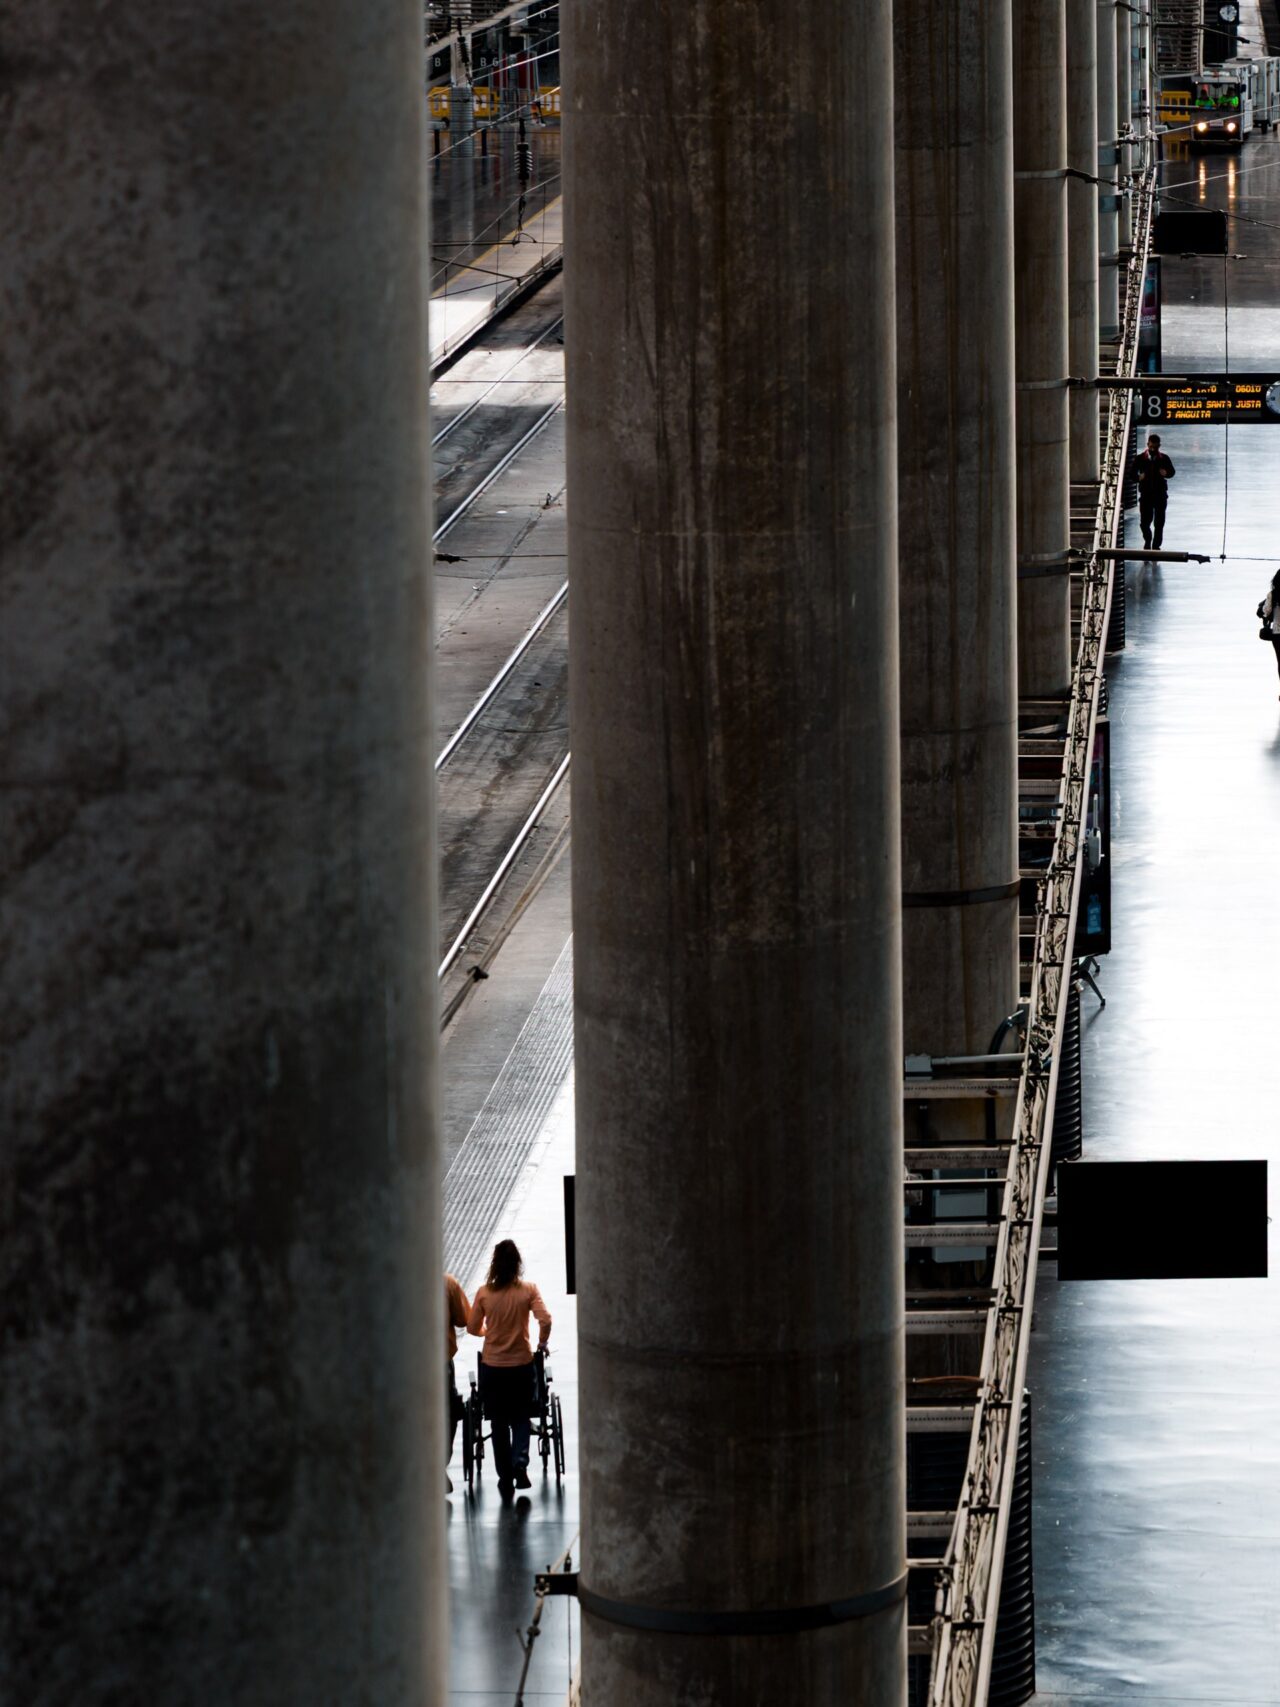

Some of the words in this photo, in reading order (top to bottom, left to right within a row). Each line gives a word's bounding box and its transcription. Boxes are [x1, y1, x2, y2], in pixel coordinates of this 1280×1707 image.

[1147, 395, 1162, 418] 8
[1166, 401, 1203, 409] SEVILLA
[1206, 401, 1232, 409] SANTA
[1235, 401, 1262, 409] JUSTA
[1175, 411, 1211, 419] ANGUITA
